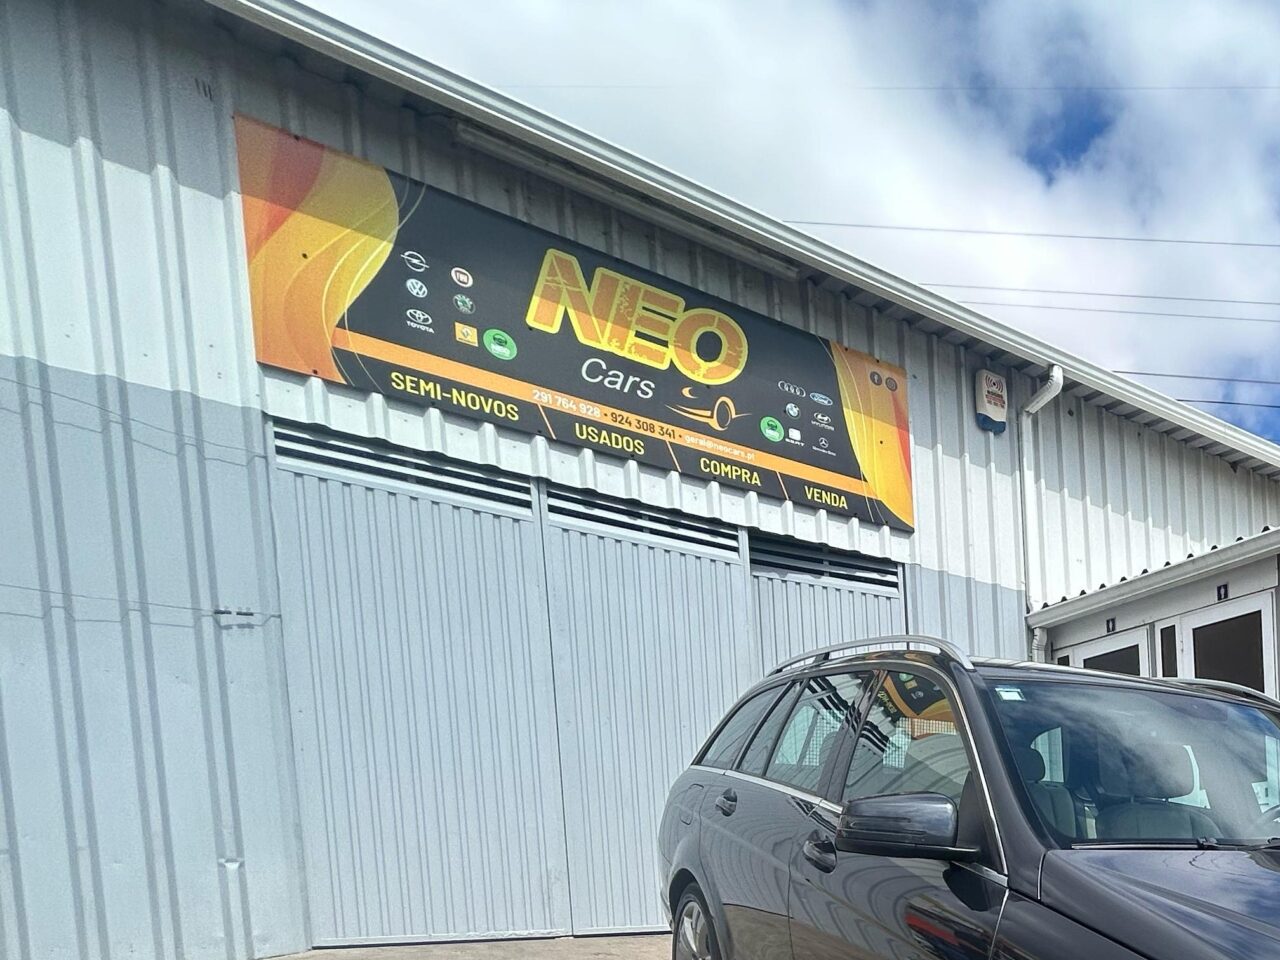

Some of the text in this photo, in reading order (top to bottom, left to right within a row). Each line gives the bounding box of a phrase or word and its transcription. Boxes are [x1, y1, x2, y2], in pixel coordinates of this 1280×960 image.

[406, 320, 435, 334] TOYOTA
[526, 248, 748, 385] NEO
[581, 358, 655, 398] Cars
[390, 372, 519, 421] SEMI-NOVOS
[532, 389, 553, 404] 291
[555, 395, 576, 412] 764
[579, 402, 600, 418] 928
[610, 412, 632, 427] 924
[635, 418, 655, 434] 308
[658, 425, 676, 439] 341
[575, 423, 645, 455] USADOS
[700, 457, 761, 486] COMPRA
[804, 485, 848, 510] VENDA
